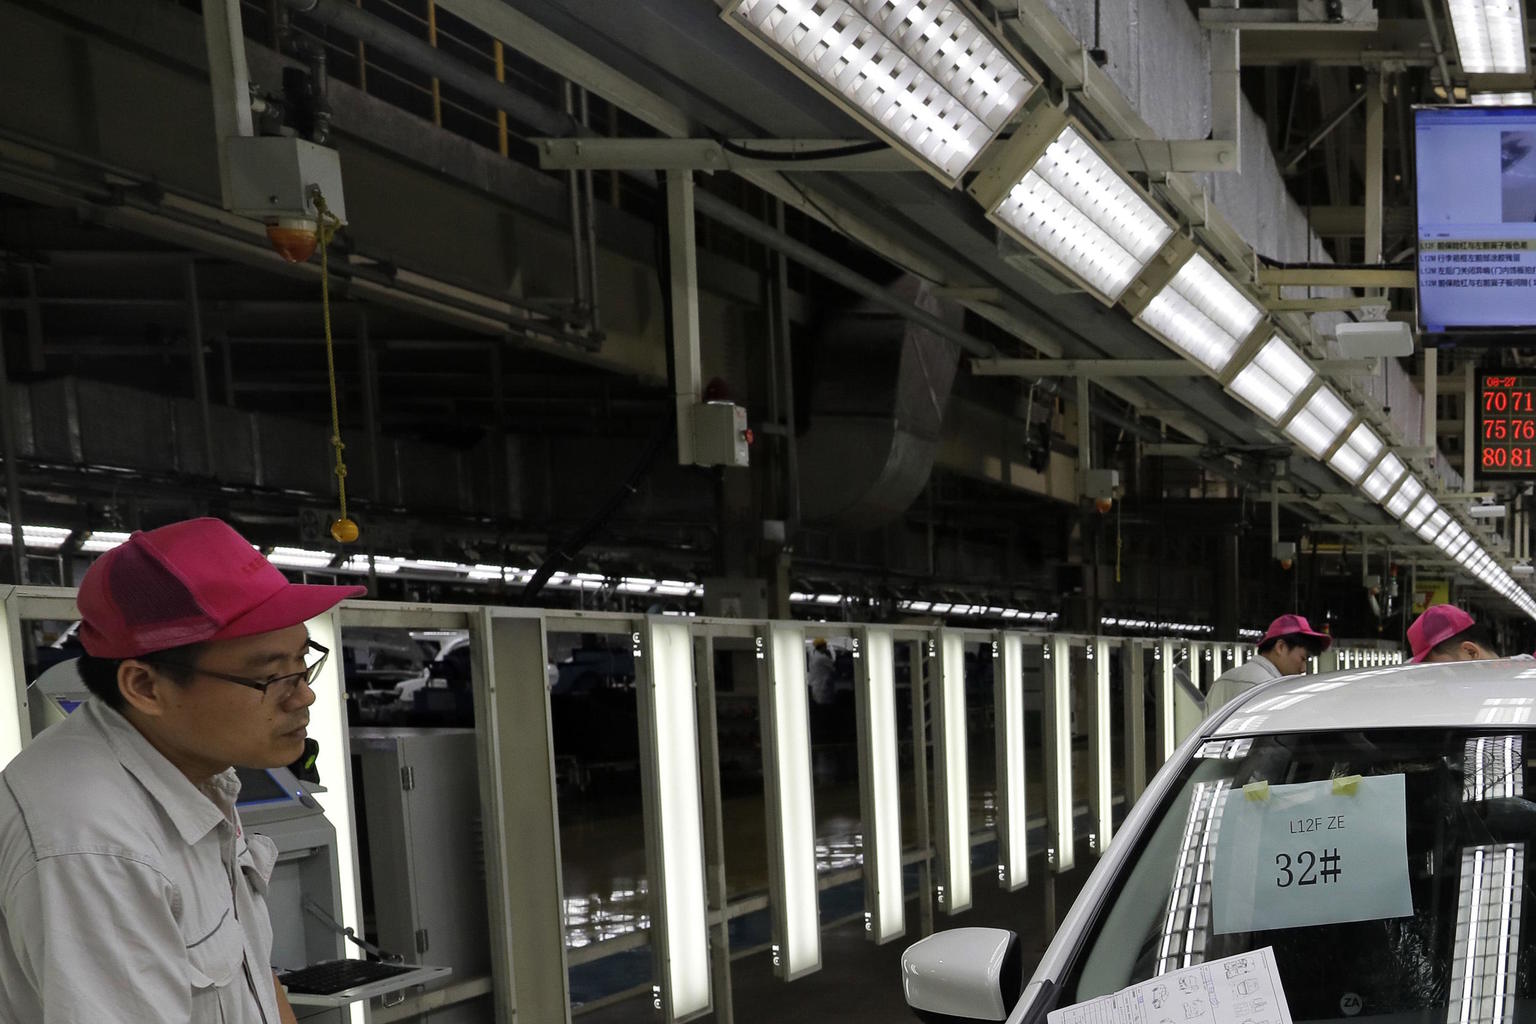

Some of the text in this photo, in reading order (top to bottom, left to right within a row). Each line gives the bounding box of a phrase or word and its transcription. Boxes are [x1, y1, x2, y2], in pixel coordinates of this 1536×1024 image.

[1483, 391, 1507, 412] 70
[1511, 391, 1534, 412] 71
[1483, 420, 1507, 440] 75
[1511, 420, 1535, 440] 76
[1482, 448, 1507, 467] 80
[1510, 448, 1534, 467] 81
[1290, 815, 1345, 834] L12F ZE
[1275, 847, 1342, 888] 32#
[1343, 997, 1360, 1009] ZA
